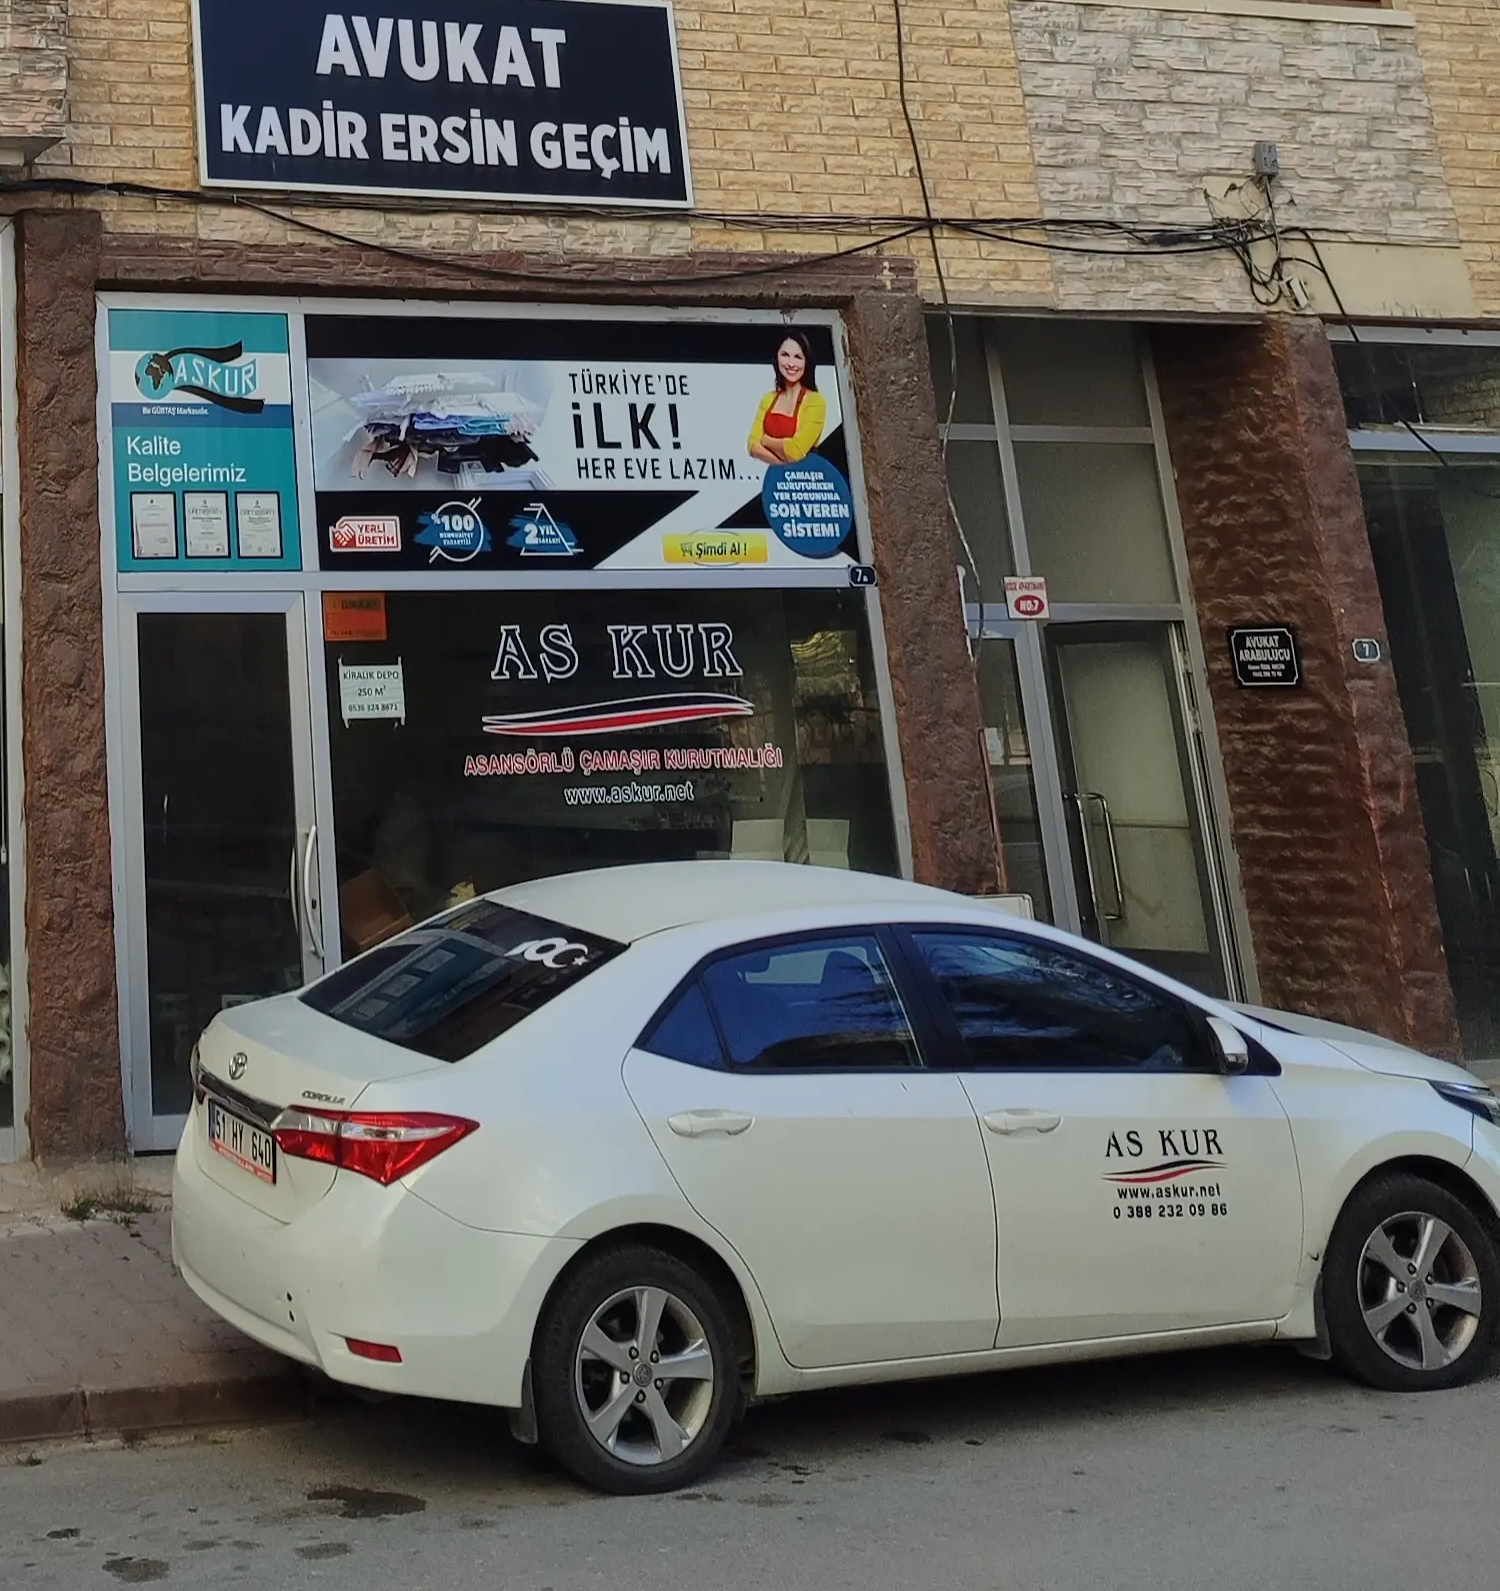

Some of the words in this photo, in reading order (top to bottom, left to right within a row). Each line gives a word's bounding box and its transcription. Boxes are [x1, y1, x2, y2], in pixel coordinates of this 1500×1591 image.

[316, 14, 566, 88] AVUKAT
[220, 100, 369, 160] KADİR
[380, 108, 518, 167] ERSİN
[530, 116, 671, 179] GEÇİM
[174, 356, 255, 395] ASKUR
[569, 368, 690, 396] TÜRKİYE'DE
[571, 402, 681, 450] İLK!
[127, 435, 181, 456] Kalite
[128, 463, 246, 487] Belgelerimiz
[577, 458, 616, 480] HER
[624, 458, 661, 480] EVE
[784, 471, 824, 481] ÇAMAŞIR
[773, 492, 791, 501] YER
[769, 503, 801, 518] SON
[802, 503, 849, 518] VEREN
[356, 523, 386, 533] YERLİ
[431, 513, 475, 531] %100
[782, 519, 841, 538] SİSTEM!
[358, 533, 395, 546] ÜRETİM
[524, 523, 539, 544] 2
[539, 525, 556, 536] YIL
[695, 542, 727, 559] Şimdi
[1246, 635, 1279, 648] AVUKAT
[1362, 643, 1370, 657] 7
[491, 624, 580, 684] AS
[607, 623, 744, 679] KUR
[1240, 649, 1291, 661] ARABULUCU
[343, 670, 374, 680] KİRALIK
[377, 671, 399, 680] DEPO
[358, 688, 372, 696] 250
[464, 747, 575, 777] ASANSÖRLÜ
[579, 748, 660, 776] ÇAMAŞIR
[664, 742, 783, 770] KURUTMALIĞI
[564, 781, 694, 805] www.askur.net
[216, 1110, 226, 1143] 51
[232, 1119, 244, 1153] HY
[251, 1130, 271, 1168] 640
[1105, 1131, 1143, 1157] AS
[1158, 1129, 1224, 1156] KUR
[1117, 1183, 1221, 1199] www.askur.net
[1113, 1206, 1121, 1219] 0
[1127, 1205, 1152, 1218] 388
[1158, 1204, 1184, 1217] 232
[1189, 1203, 1205, 1216] 09
